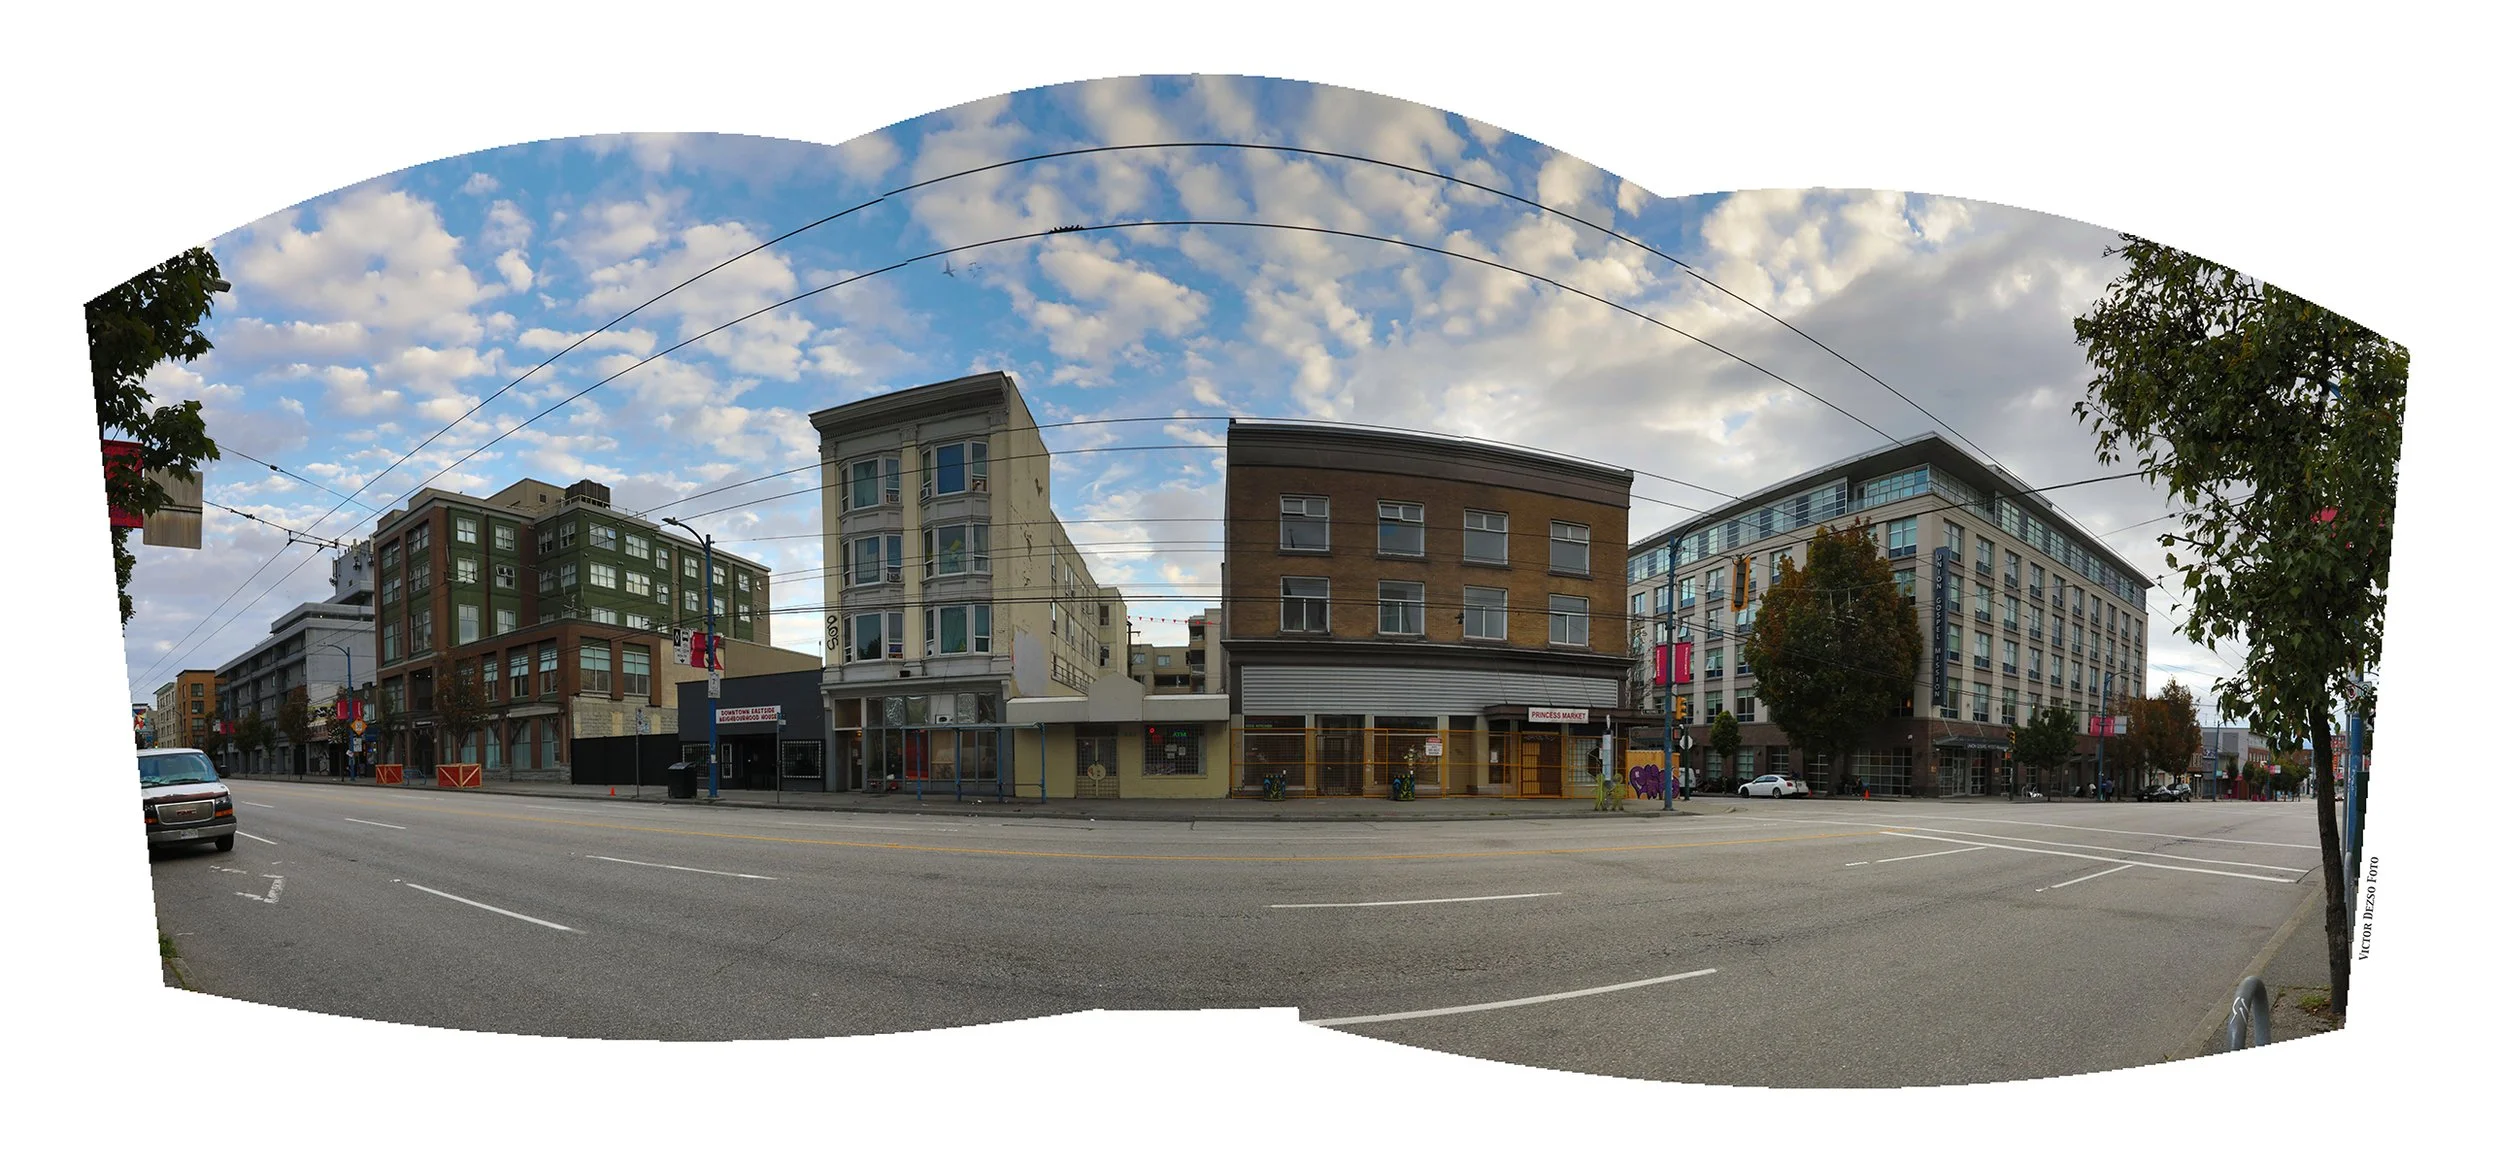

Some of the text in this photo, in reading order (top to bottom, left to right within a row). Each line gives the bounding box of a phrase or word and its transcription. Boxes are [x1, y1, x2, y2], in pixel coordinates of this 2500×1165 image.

[720, 714, 759, 722] NEIGHBOURHOOD
[1532, 711, 1586, 720] PRINCESS MARKET
